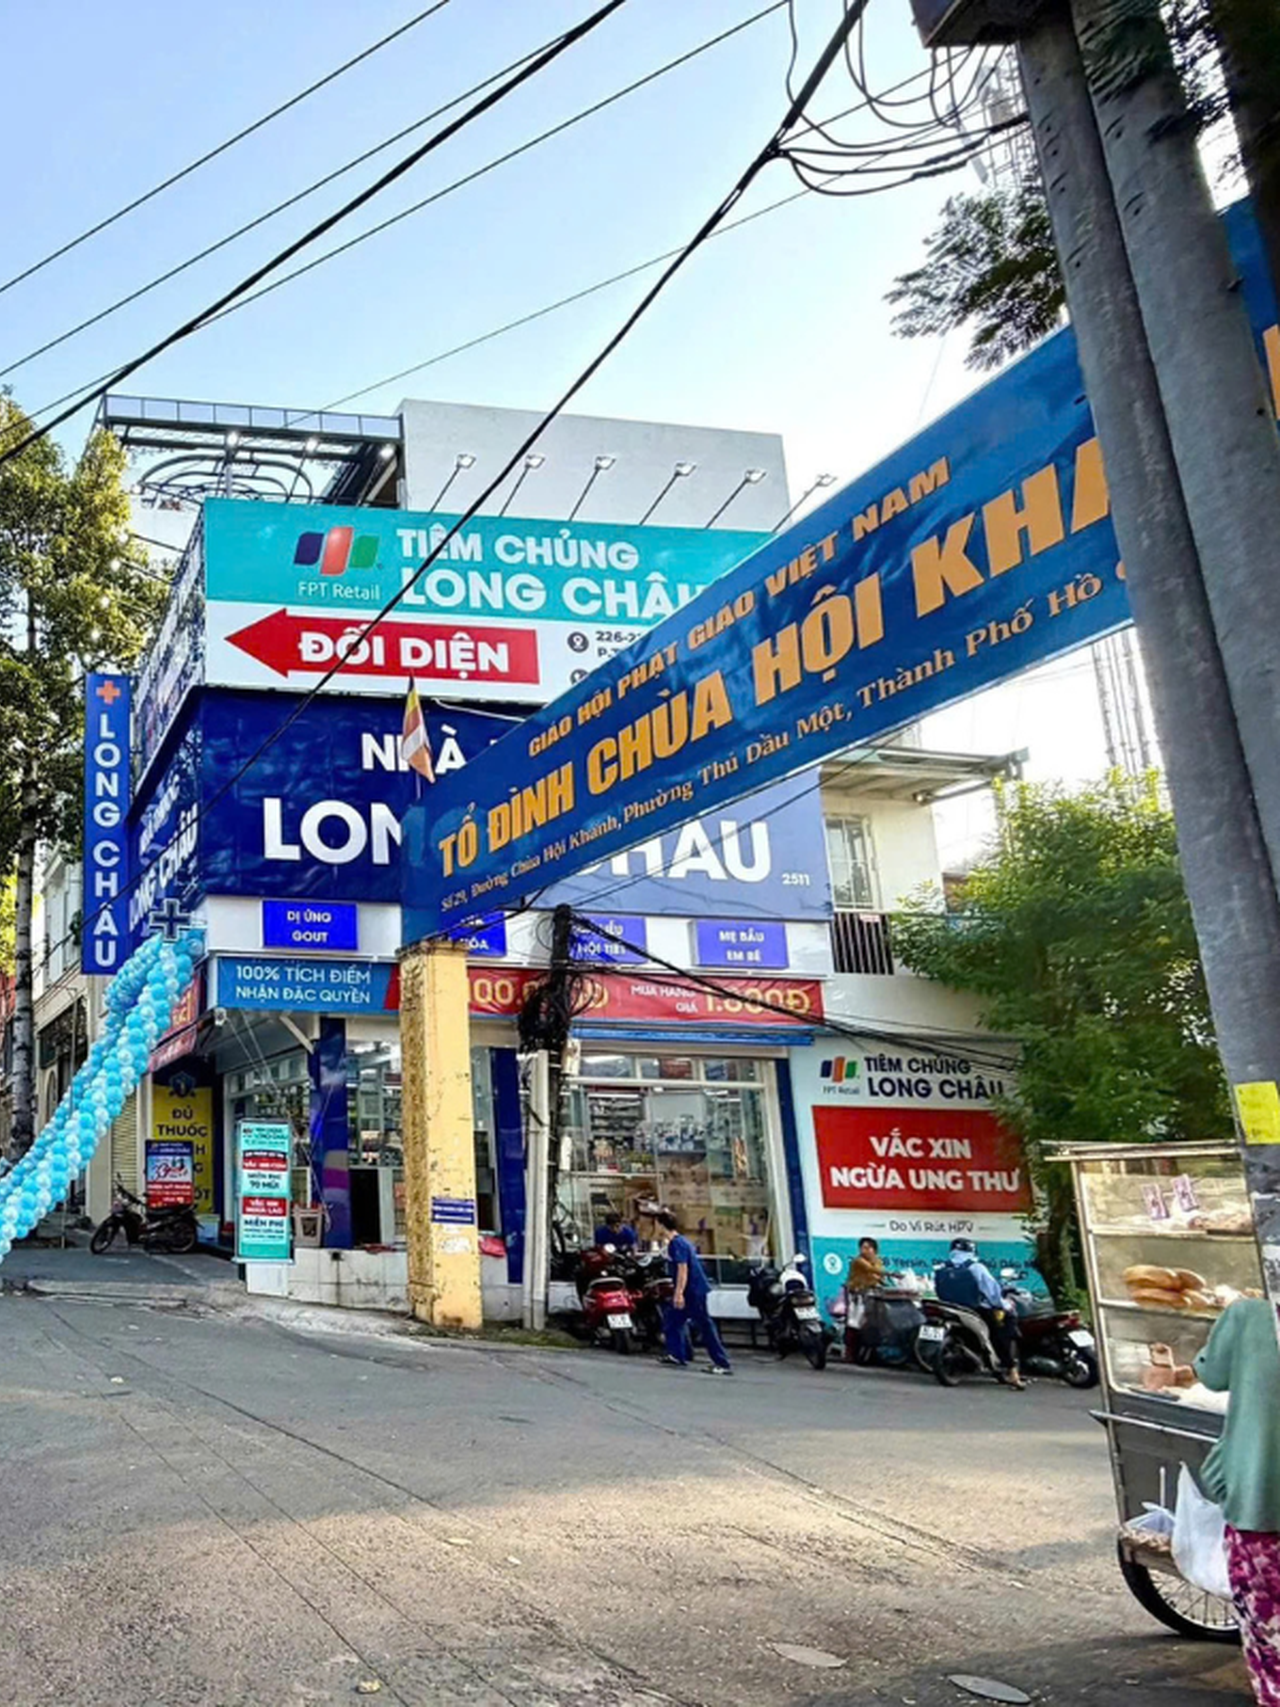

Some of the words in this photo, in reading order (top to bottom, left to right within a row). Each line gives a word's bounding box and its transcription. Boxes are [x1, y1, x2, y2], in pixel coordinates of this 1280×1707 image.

[396, 522, 483, 562] TIÊM
[494, 528, 639, 571] CHỦNG
[298, 580, 327, 598] FPT
[332, 583, 382, 600] Retail
[401, 566, 547, 612] LONG
[529, 715, 572, 757] GIÁO
[578, 688, 613, 727] HỘI
[687, 590, 755, 651] GIÁO
[764, 531, 839, 598] VIỆT
[852, 456, 951, 542] NAM
[298, 623, 385, 666] ĐỐI
[399, 631, 510, 680] DIỆN
[856, 648, 957, 710] Thành
[965, 599, 1035, 657] Phố
[1047, 572, 1104, 617] Hồ
[487, 761, 576, 853] ĐÌNH
[586, 668, 734, 796] CHÙA
[751, 572, 885, 706] HỘI
[94, 713, 123, 829] LONG
[263, 797, 426, 866] LON
[93, 840, 121, 967] CHÂU
[292, 930, 329, 943] GOUT
[726, 950, 745, 961] EM
[236, 965, 280, 981] 100%
[284, 962, 325, 983] TÍCH
[329, 964, 371, 985] ĐIỂM
[236, 984, 279, 1003] NHẬN
[283, 986, 317, 1004] ĐẶC
[319, 985, 370, 1005] QUYỀN
[631, 985, 657, 997] MUA
[864, 1053, 903, 1074] TIÊM
[907, 1055, 972, 1075] CHỦNG
[867, 1077, 932, 1099] LONG
[172, 1104, 193, 1120] ĐỦ
[156, 1121, 208, 1137] THUỐC
[870, 1127, 923, 1158] VẮC
[928, 1137, 972, 1160] XIN
[830, 1162, 905, 1190] NGỪA
[910, 1167, 963, 1192] UNG
[967, 1167, 1020, 1193] THƯ
[890, 1220, 907, 1233] Do
[924, 1220, 946, 1233] Rút
